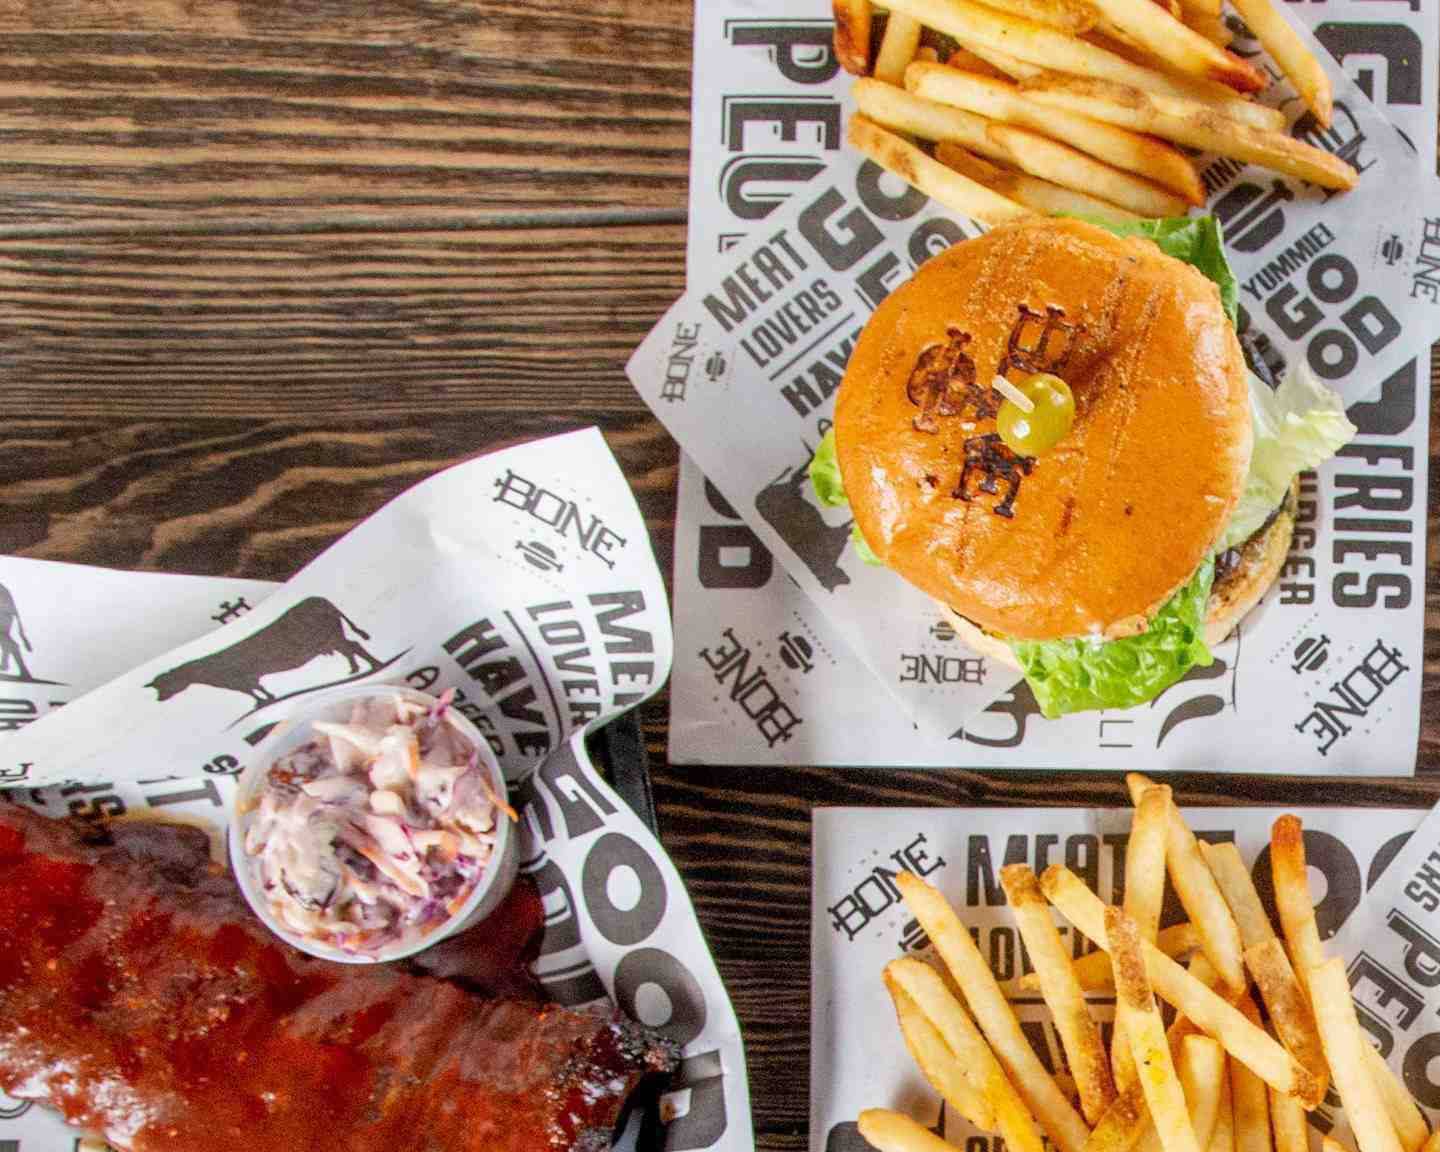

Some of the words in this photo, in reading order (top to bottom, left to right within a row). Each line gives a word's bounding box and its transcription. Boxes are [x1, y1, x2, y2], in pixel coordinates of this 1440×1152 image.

[702, 229, 808, 333] MEAT
[1240, 222, 1336, 300] YUMMIE!
[661, 322, 702, 402] BONE
[739, 279, 843, 368] LOVERS
[780, 326, 863, 418] HAV
[492, 468, 627, 571] BONE
[1332, 442, 1415, 609] FRIES
[526, 600, 603, 727] LOVER
[699, 627, 803, 749] BONE
[899, 654, 987, 686] BONE
[1294, 638, 1410, 757] BONE
[827, 832, 946, 941] BONE
